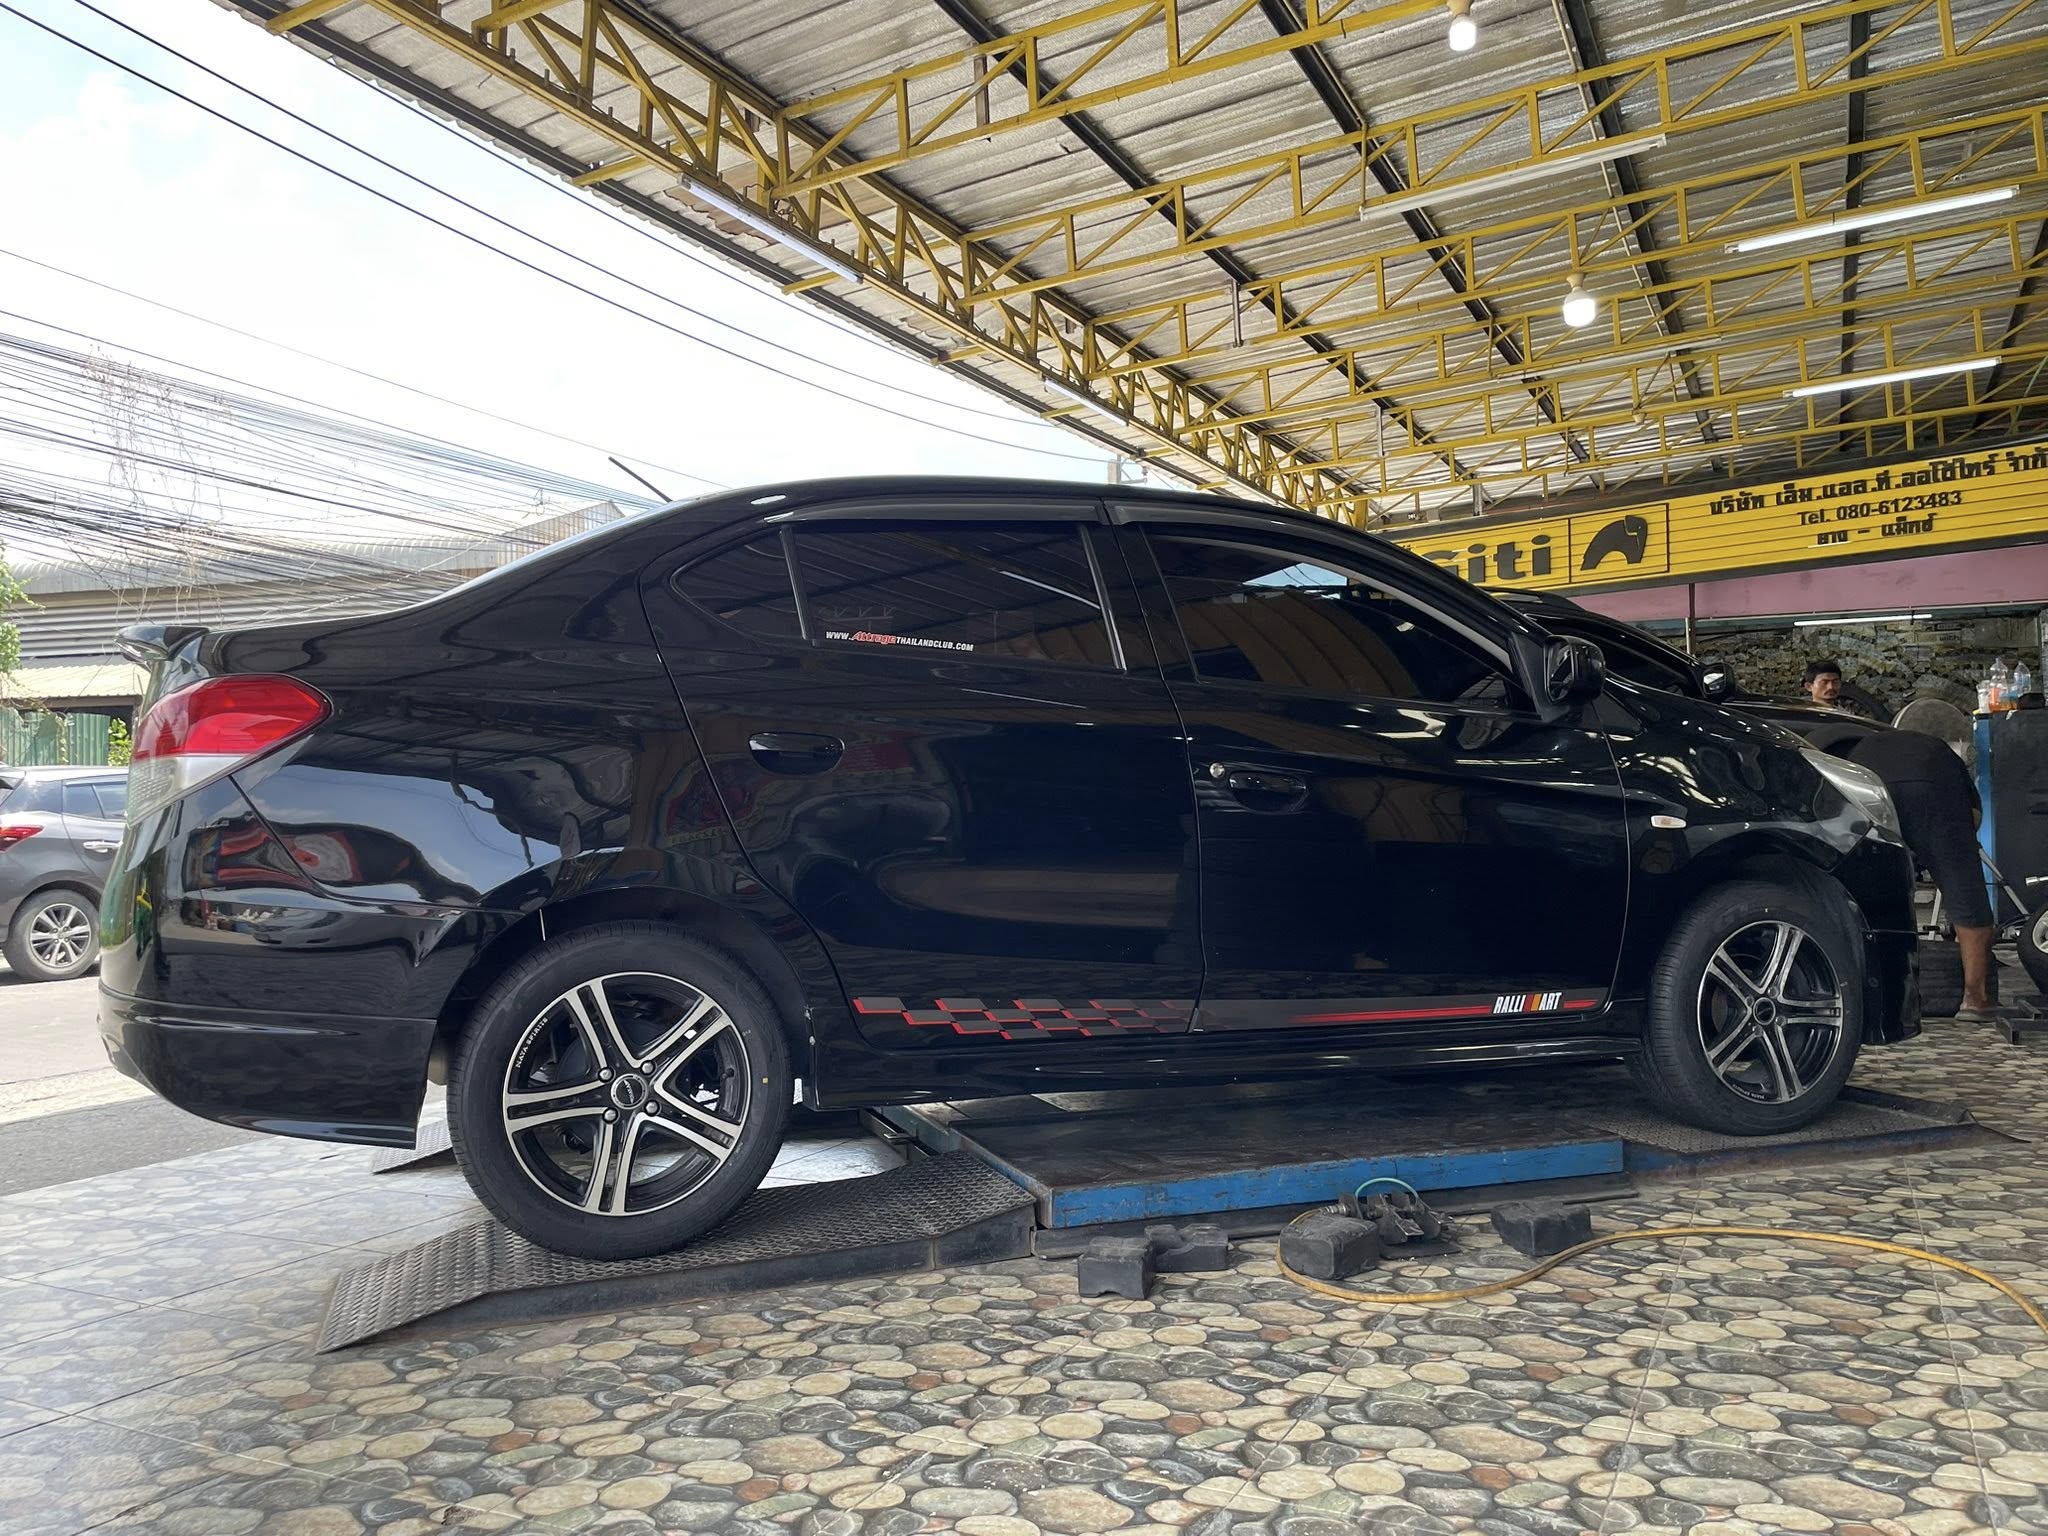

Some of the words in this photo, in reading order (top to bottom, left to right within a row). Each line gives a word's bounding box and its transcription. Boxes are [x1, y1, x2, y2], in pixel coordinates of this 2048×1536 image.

[1710, 491, 1765, 515] บริษัท
[2005, 446, 2048, 472] จำกั
[1797, 508, 1831, 526] Tel.
[1836, 490, 1962, 520] 080-6123483
